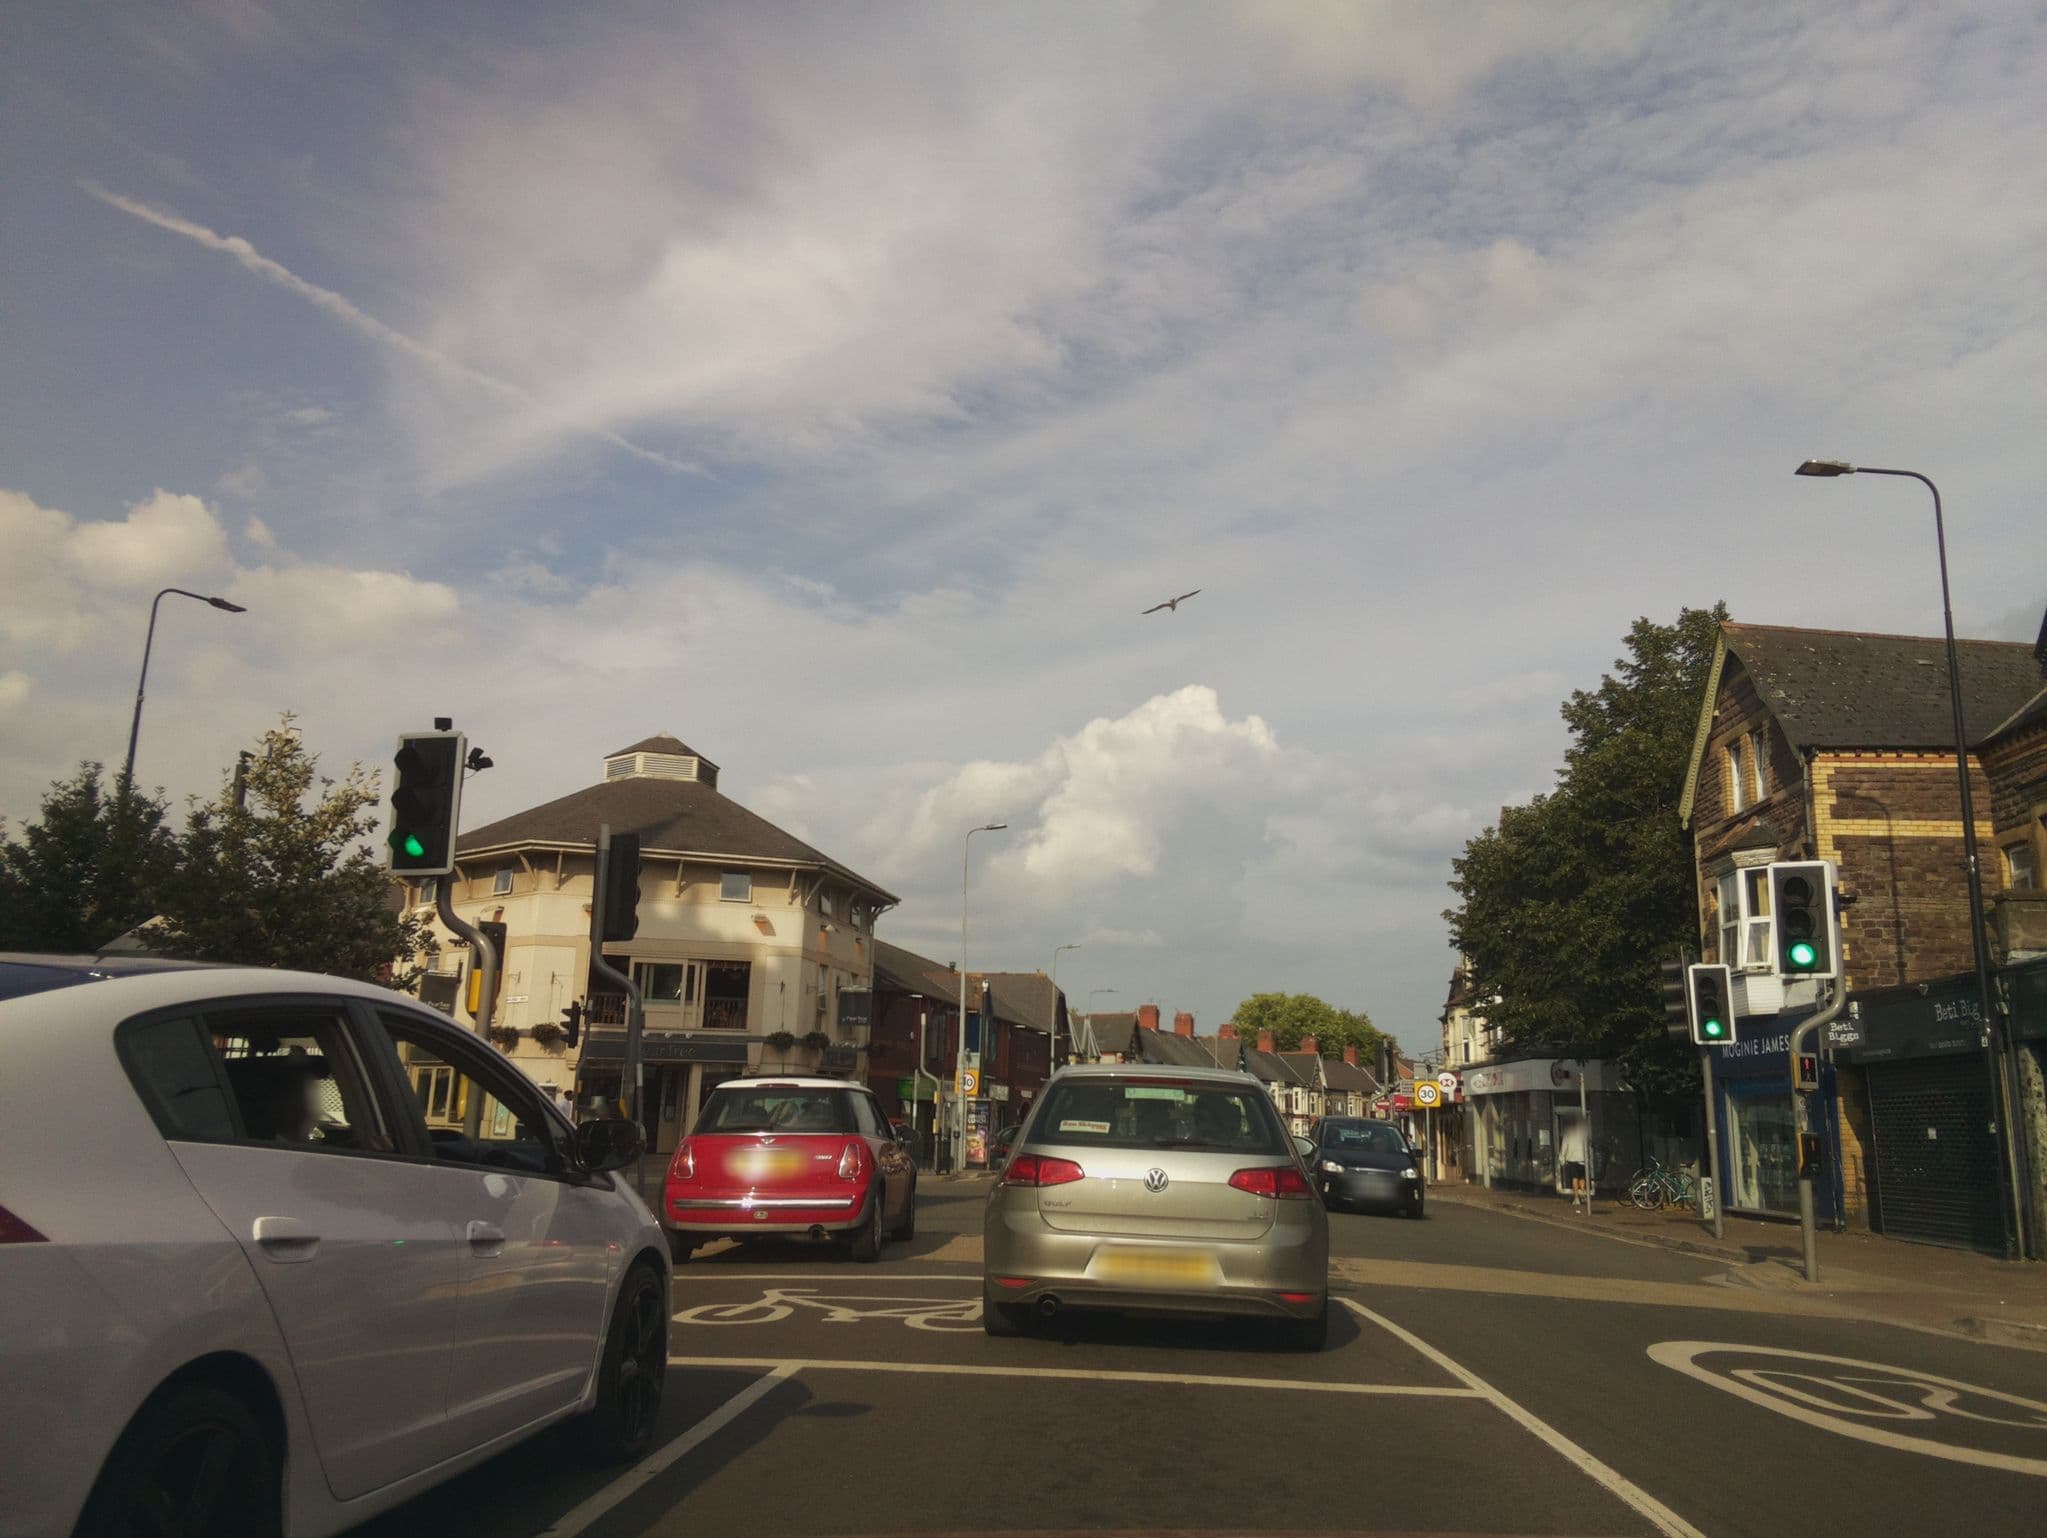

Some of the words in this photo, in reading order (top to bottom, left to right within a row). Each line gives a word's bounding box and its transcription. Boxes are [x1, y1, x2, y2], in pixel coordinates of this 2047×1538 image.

[1934, 1002, 1959, 1022] Beti
[1829, 1022, 1855, 1032] Beti
[1722, 1040, 1759, 1057] MOGINIE
[1761, 1035, 1790, 1054] JAMES
[1420, 1089, 1435, 1099] 30
